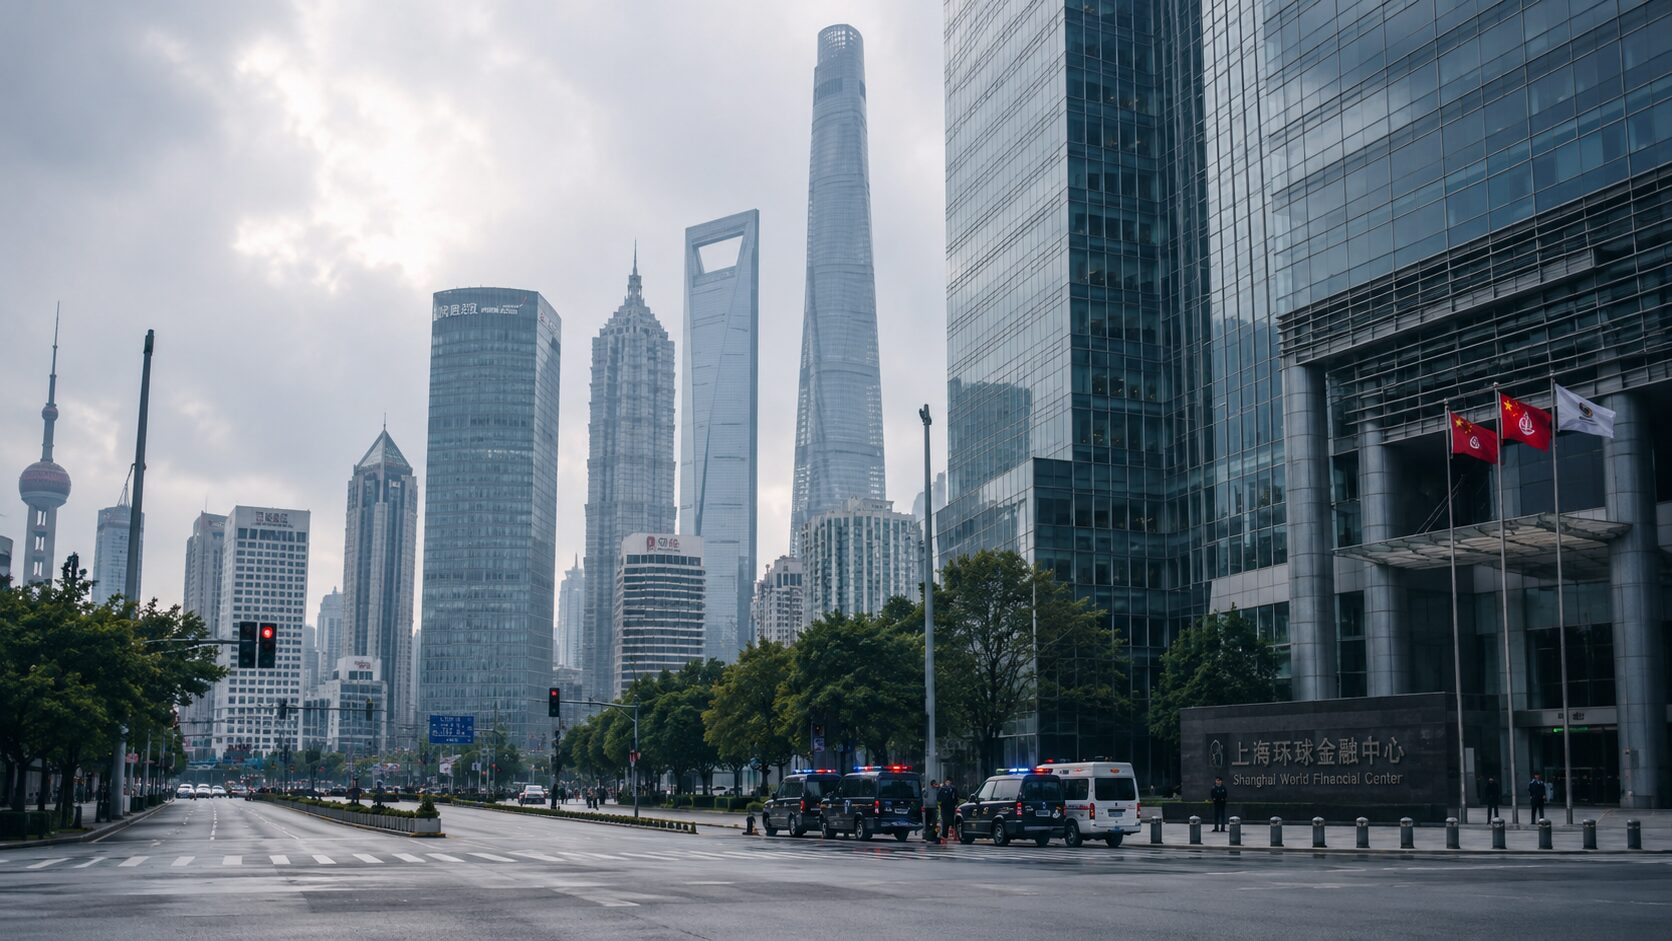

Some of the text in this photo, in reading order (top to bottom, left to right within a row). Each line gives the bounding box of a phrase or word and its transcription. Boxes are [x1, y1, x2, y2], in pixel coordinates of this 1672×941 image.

[1231, 736, 1405, 767] 上海环球金融中心
[1232, 771, 1404, 788] Shanghai World Financial Center
